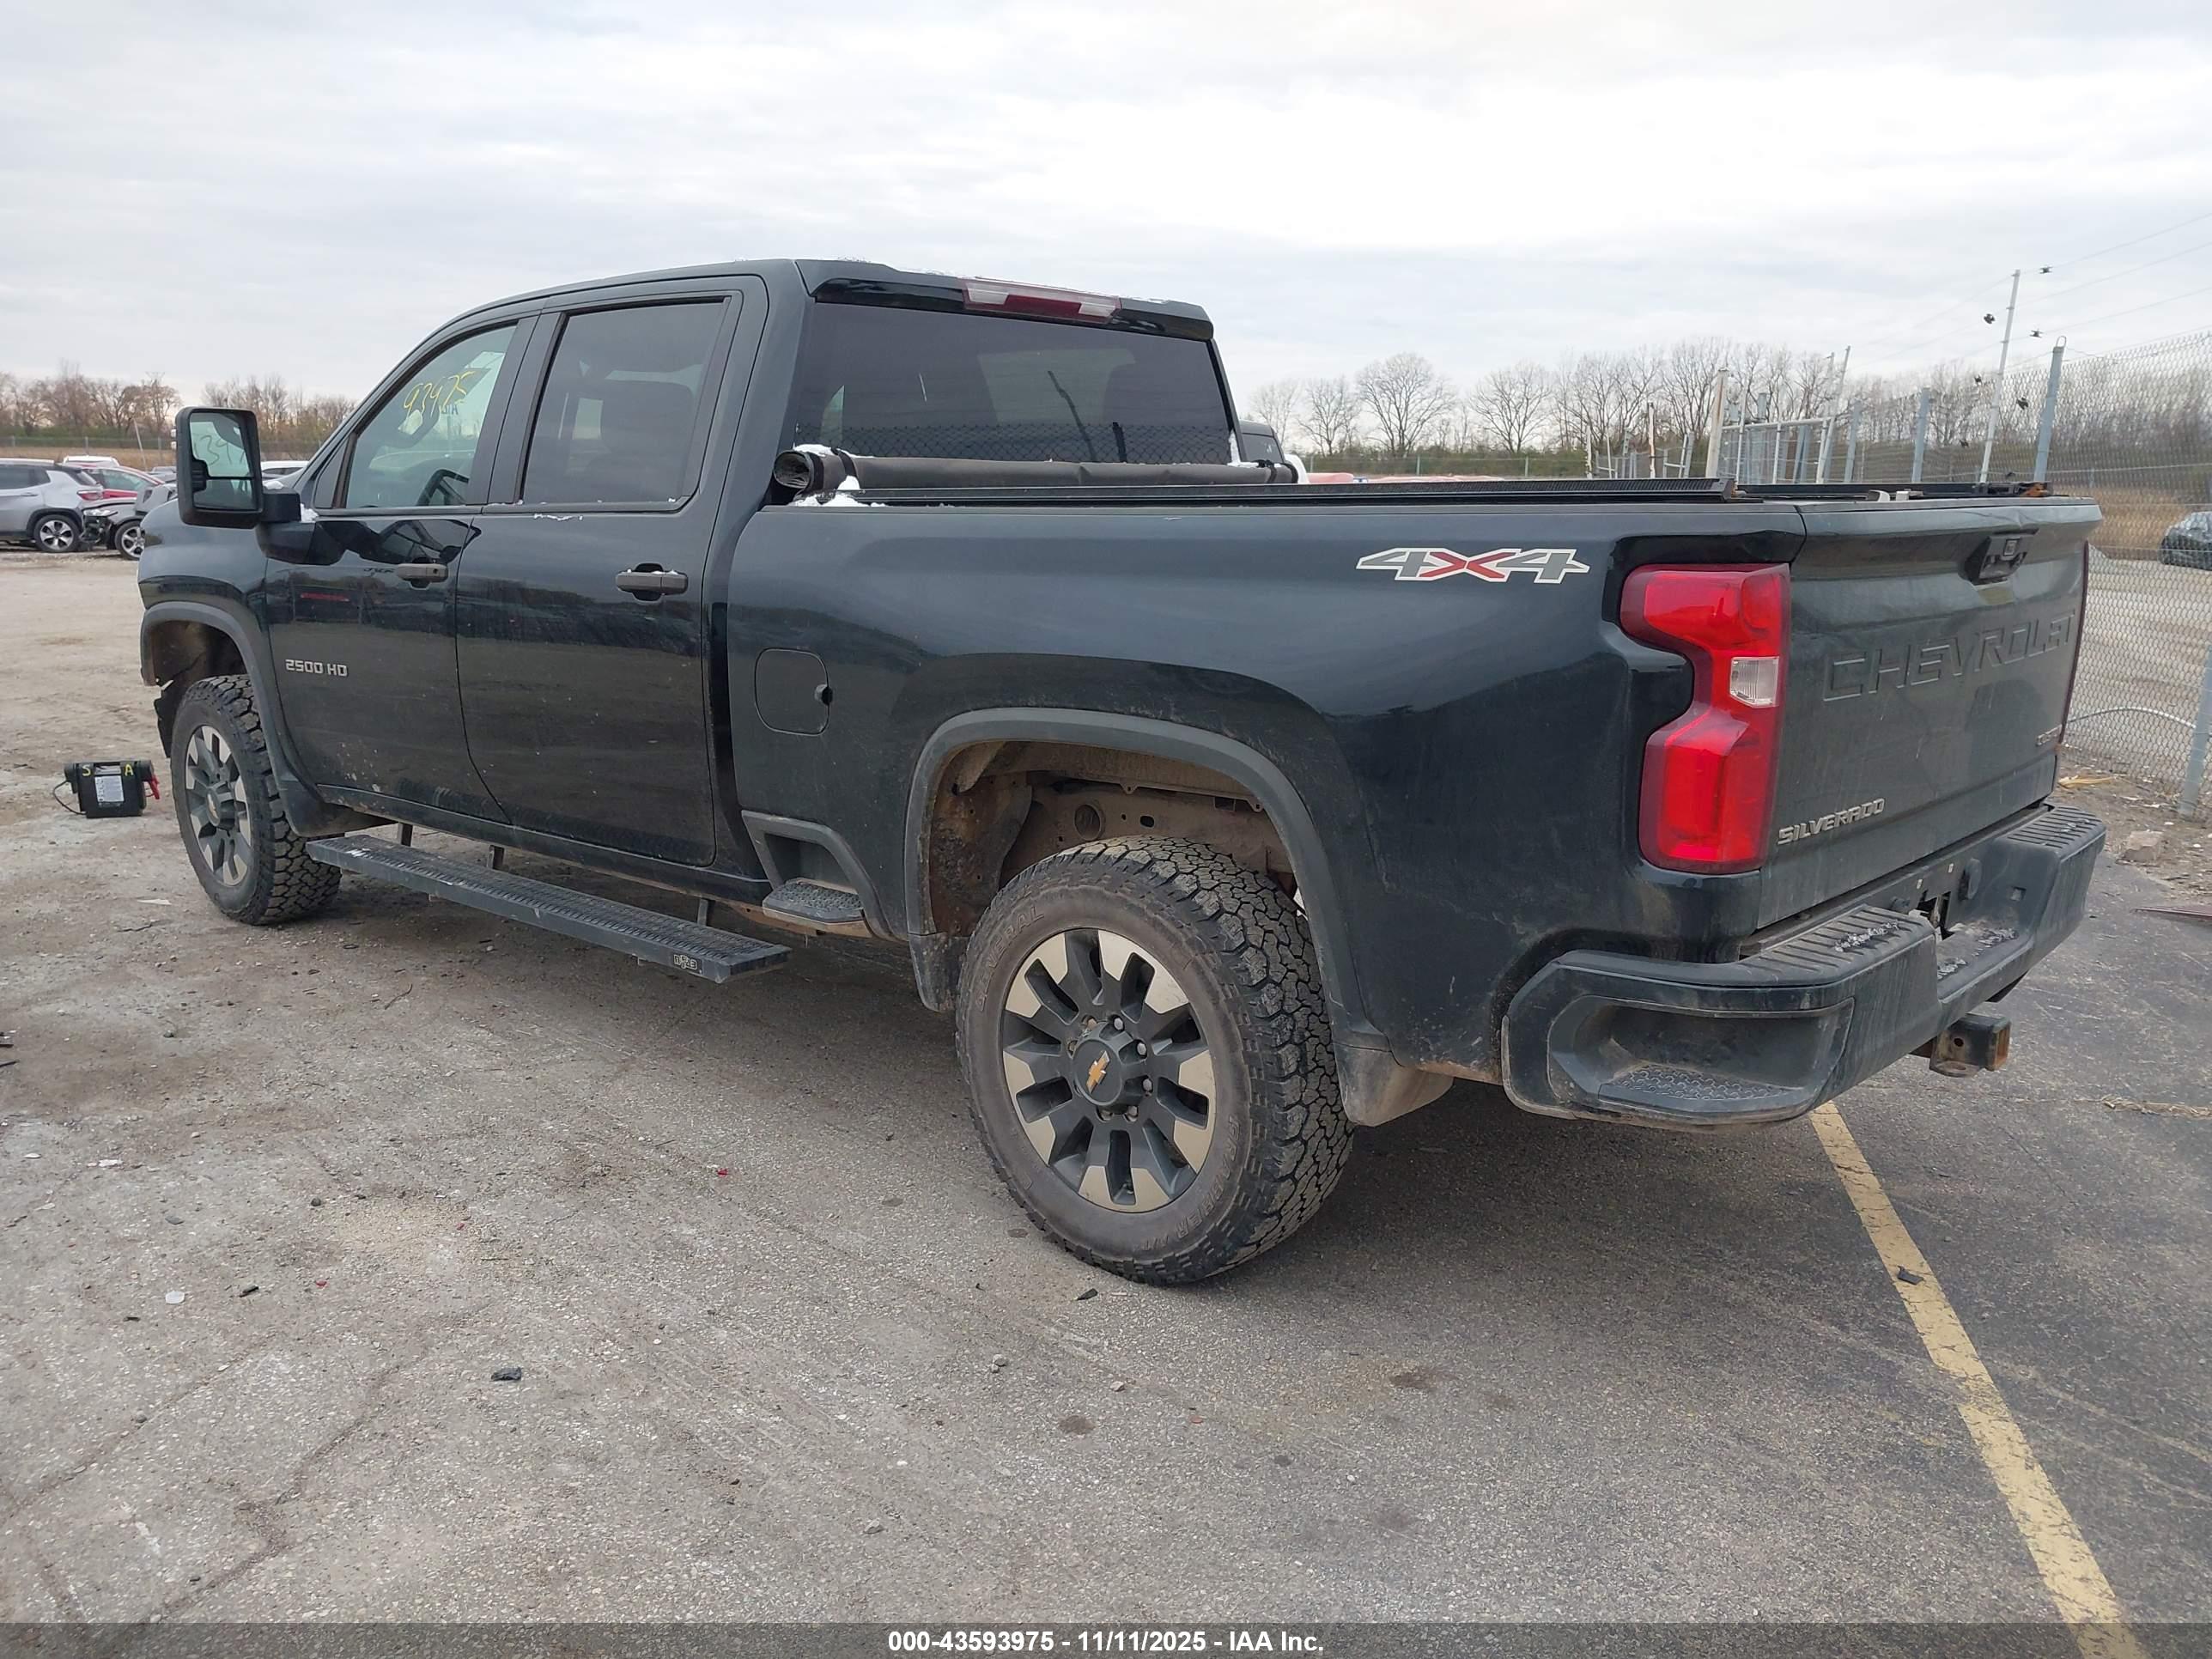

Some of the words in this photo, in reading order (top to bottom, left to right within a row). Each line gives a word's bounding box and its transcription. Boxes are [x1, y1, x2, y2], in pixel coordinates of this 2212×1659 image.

[285, 659, 324, 674] 2500
[327, 663, 348, 677] HD
[1822, 608, 2075, 702] CHEVROLET
[82, 764, 91, 776] S
[125, 763, 134, 776] A
[1778, 798, 1885, 845] SILVERADO
[1174, 1115, 1242, 1239] GRABBER
